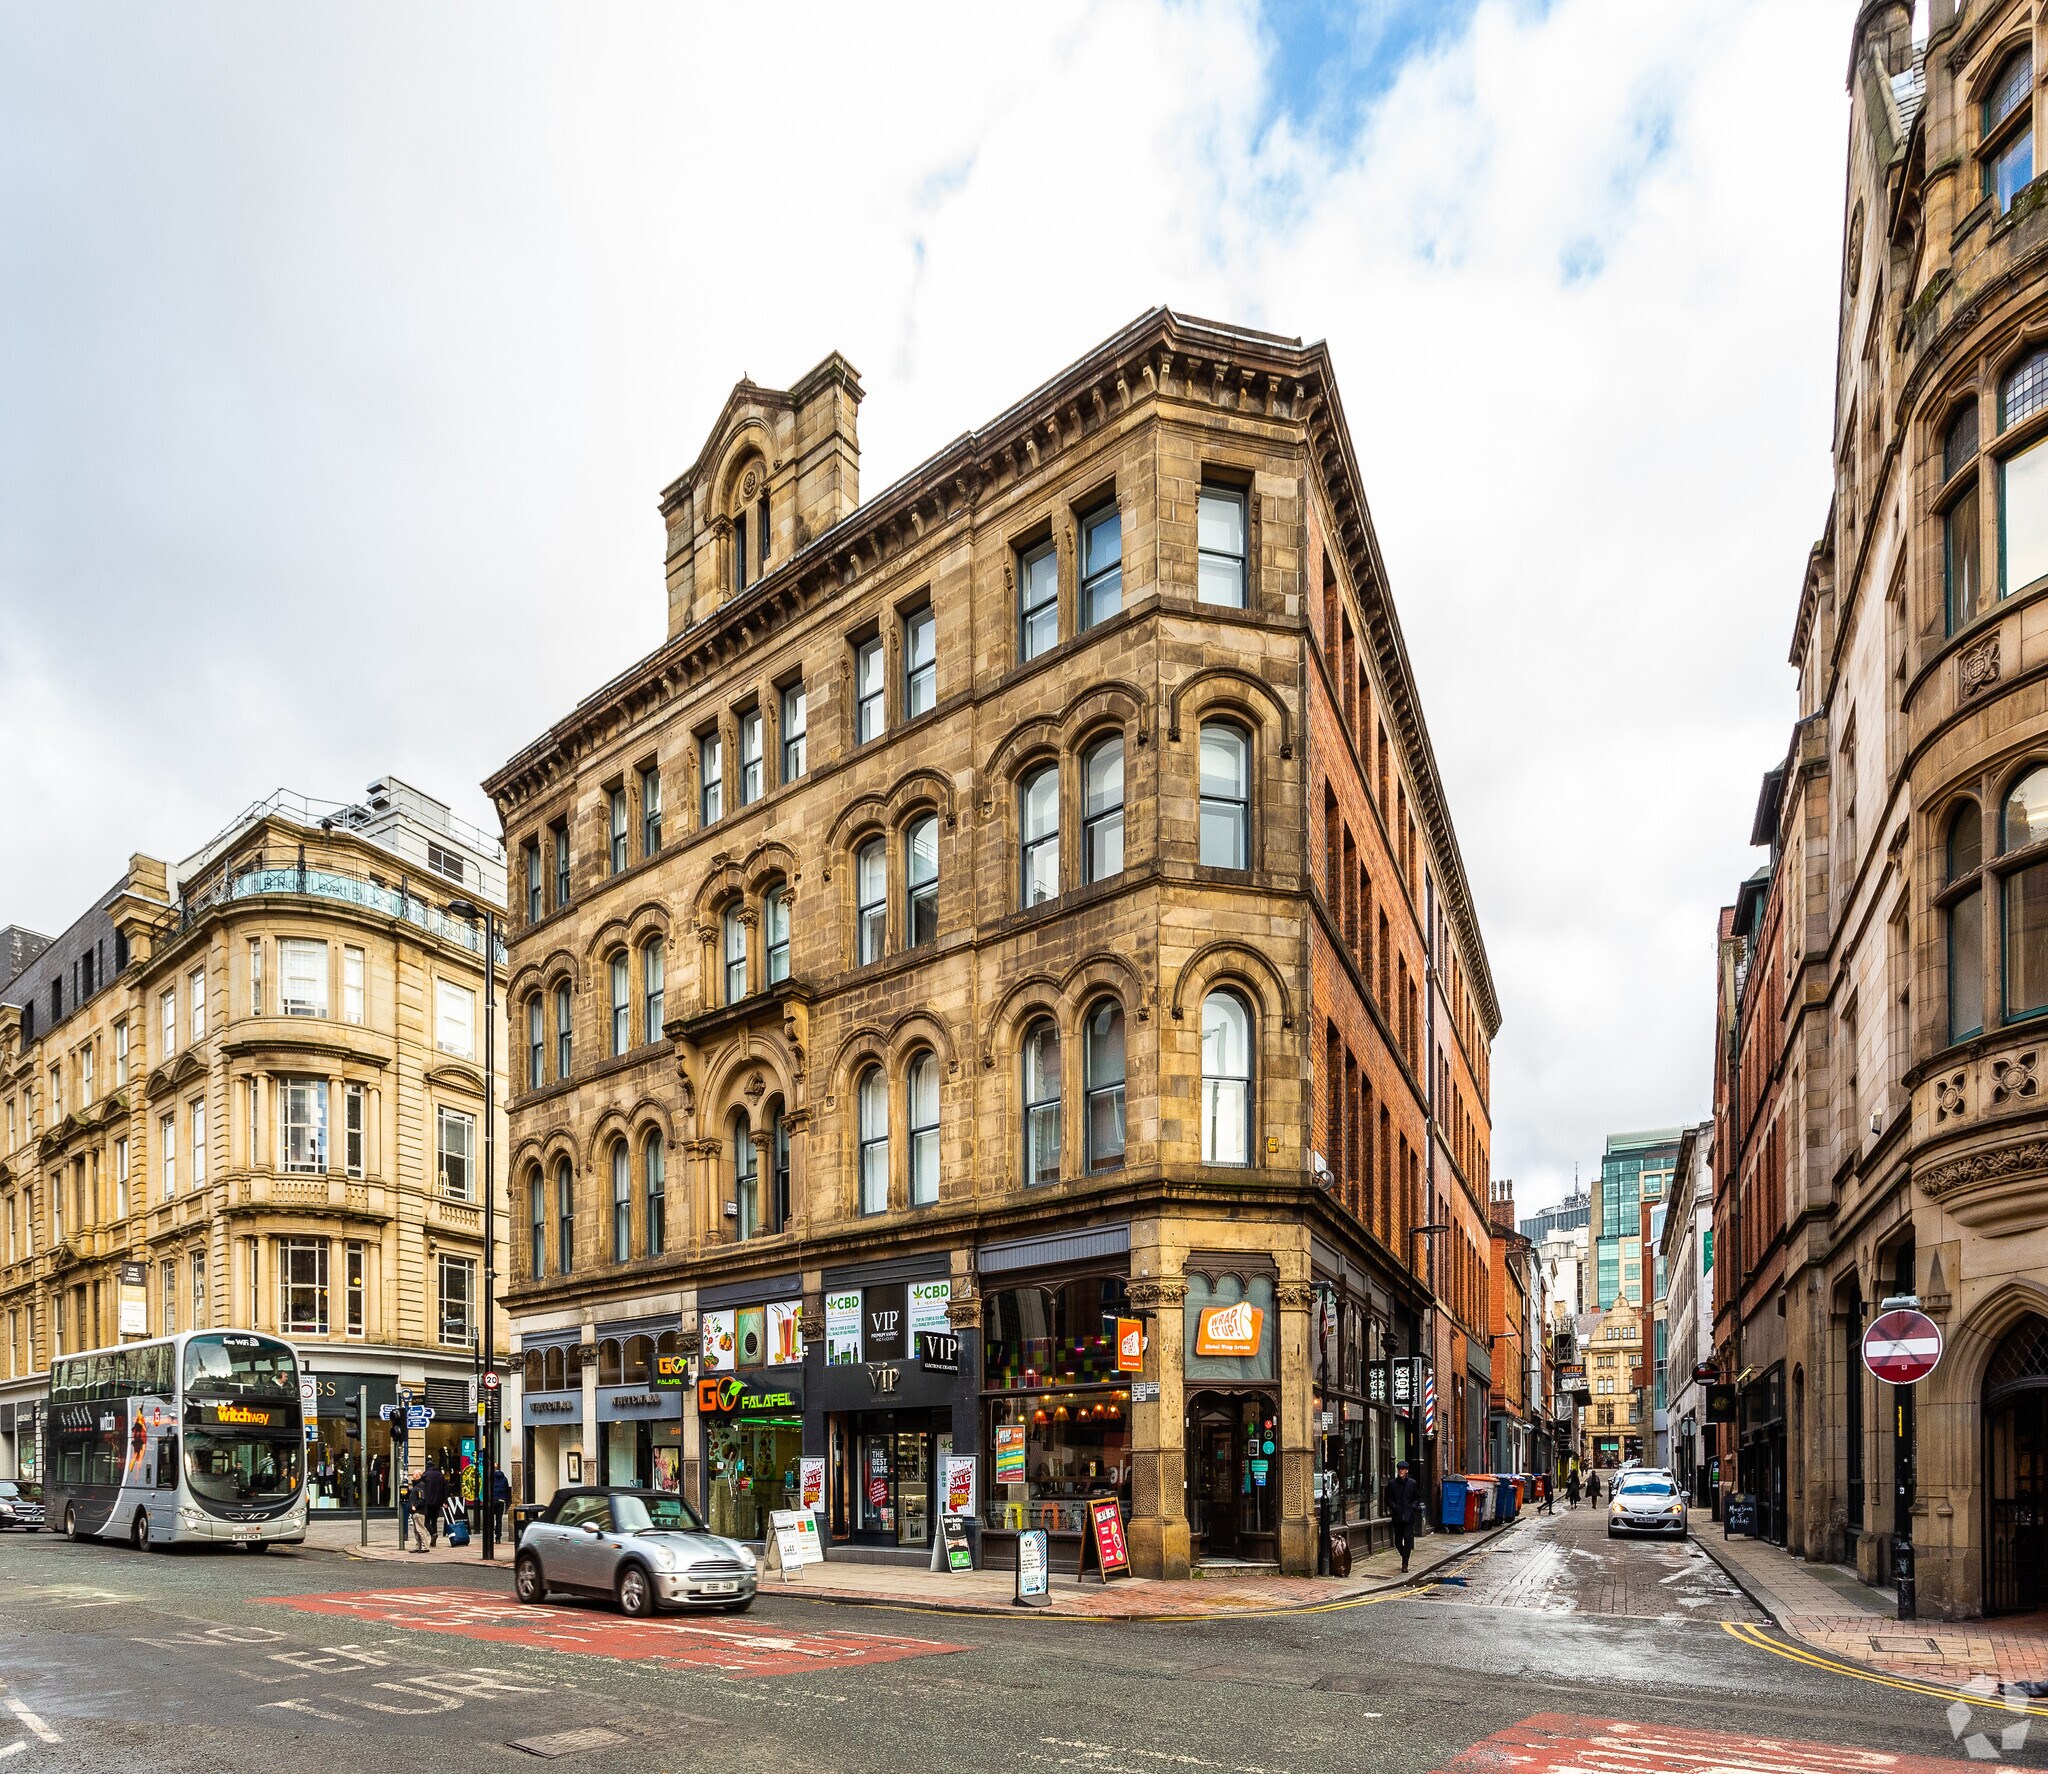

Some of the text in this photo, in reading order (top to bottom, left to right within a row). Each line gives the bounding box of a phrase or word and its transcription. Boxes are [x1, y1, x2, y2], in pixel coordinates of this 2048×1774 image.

[925, 1284, 949, 1299] CBD
[837, 1295, 859, 1310] CBD
[871, 1311, 898, 1331] VIP
[1211, 1309, 1238, 1326] WRAP
[1211, 1318, 1241, 1337] IT UP!
[223, 1337, 236, 1345] free
[925, 1335, 958, 1361] VIP
[659, 1356, 685, 1375] GO
[487, 1376, 497, 1384] 20
[868, 1369, 900, 1394] VIP
[699, 1376, 738, 1412] GO
[741, 1393, 794, 1410] FALAFEL
[217, 1406, 270, 1425] witchway
[872, 1450, 884, 1458] THE
[872, 1458, 887, 1466] BEST
[872, 1466, 888, 1474] VAPE
[804, 1474, 821, 1486] SALE
[950, 1475, 971, 1488] SALE
[447, 1496, 466, 1515] W
